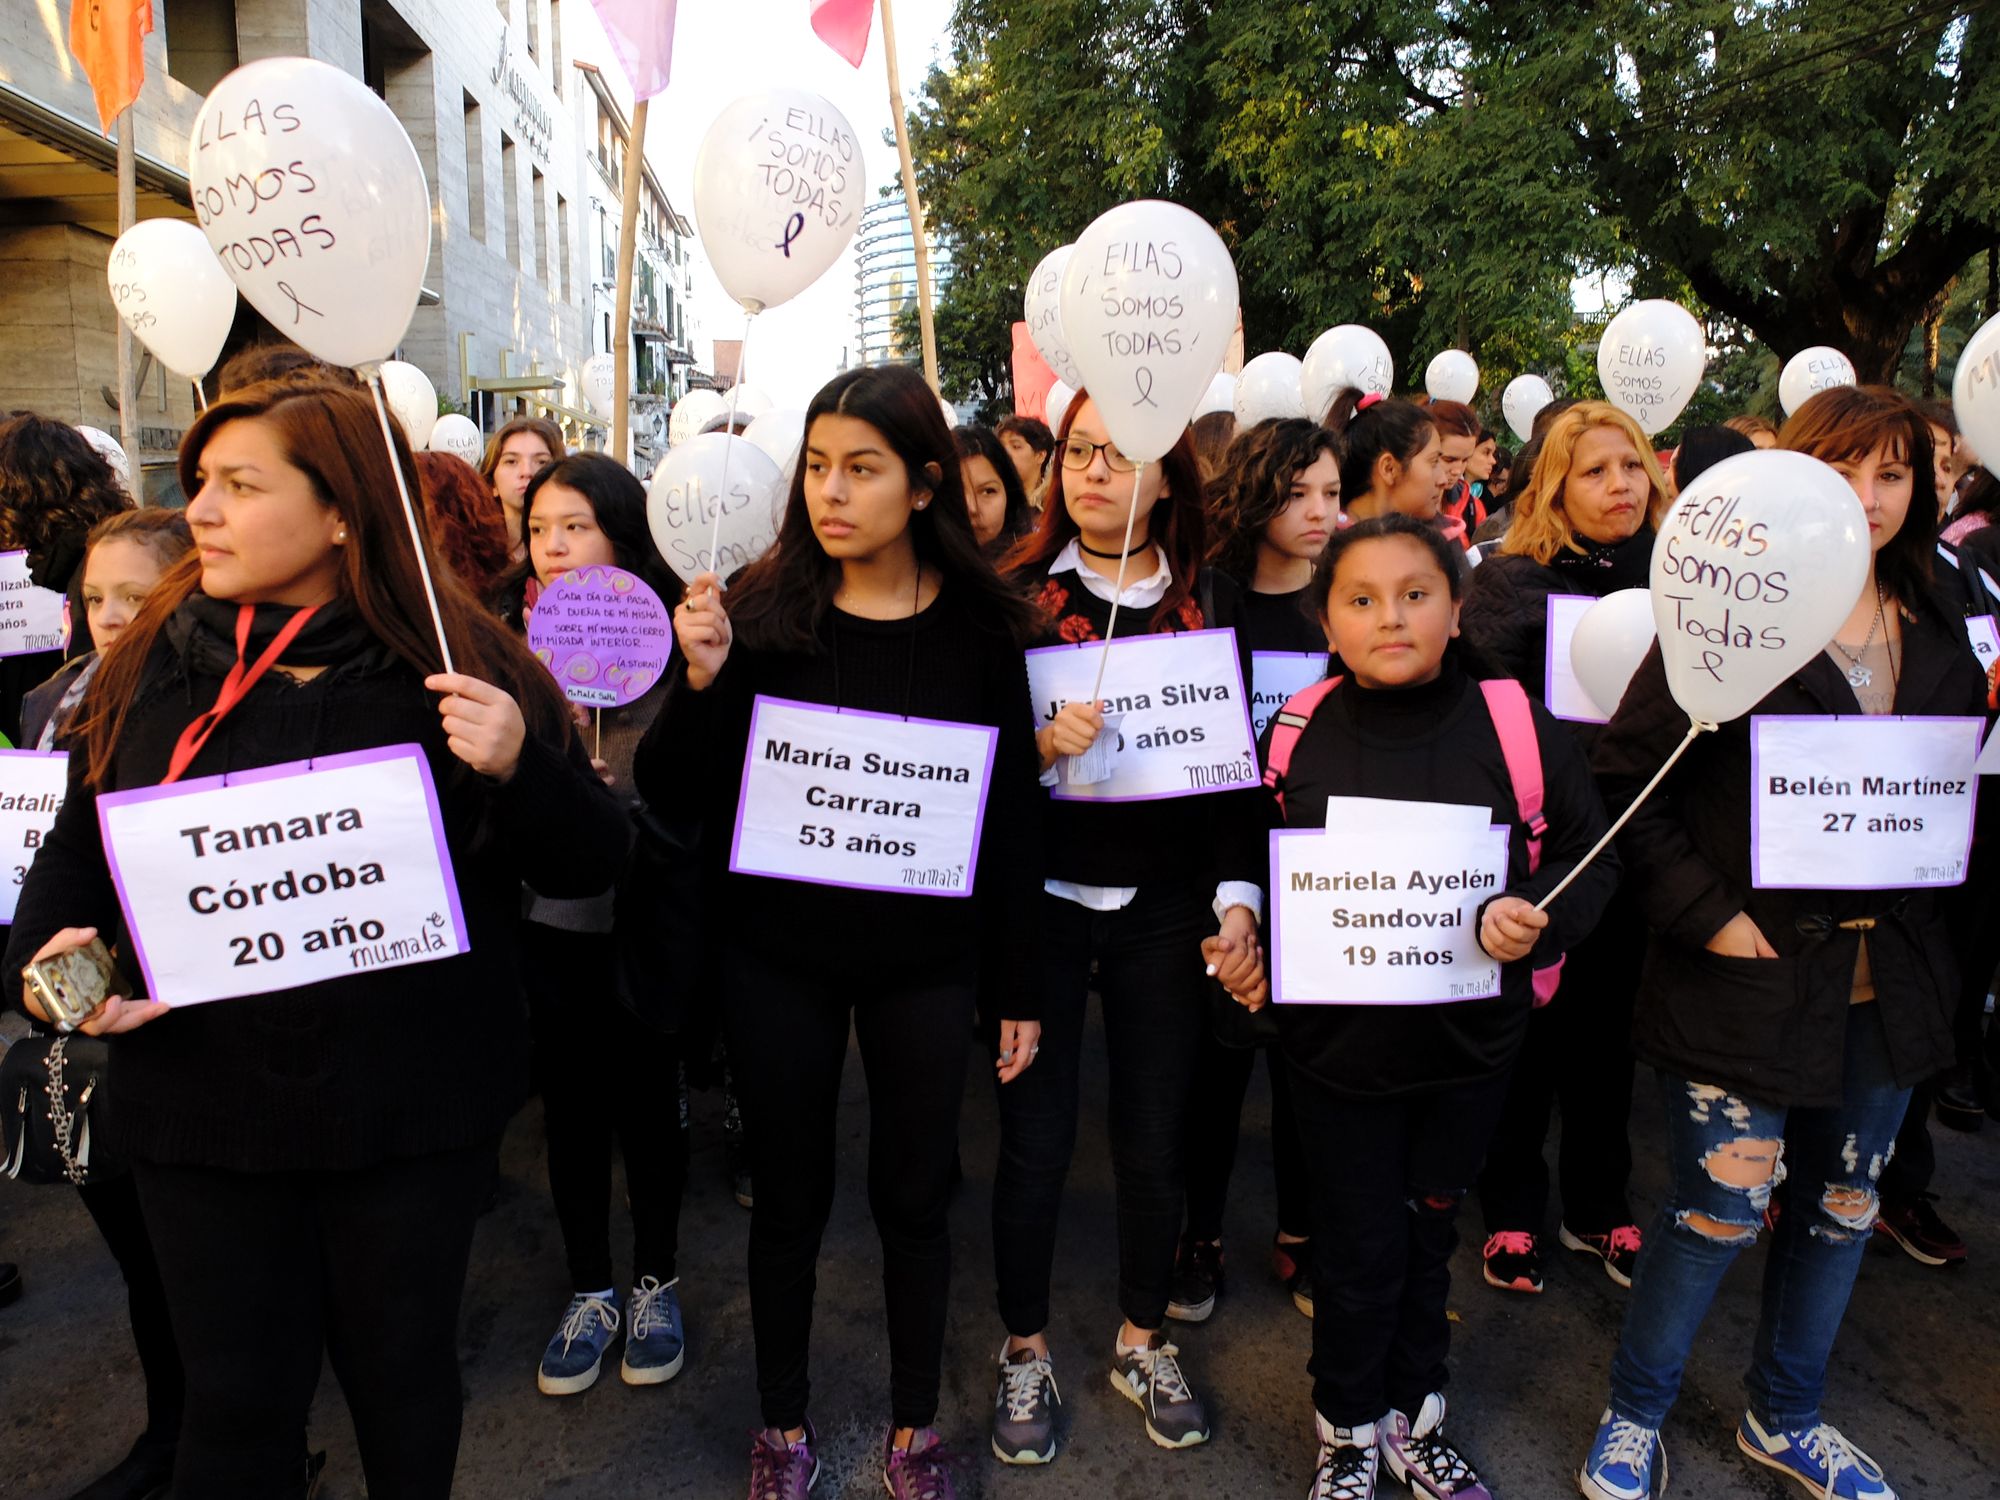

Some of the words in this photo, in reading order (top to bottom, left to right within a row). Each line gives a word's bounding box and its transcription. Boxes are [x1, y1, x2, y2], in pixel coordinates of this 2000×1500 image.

[786, 107, 853, 163] ELLAS
[195, 160, 317, 226] SOMOS
[218, 214, 336, 275] TODAS
[1103, 241, 1183, 280] ELLAS
[1100, 286, 1184, 320] SOMOS
[1618, 344, 1666, 368] ELLAS
[1611, 370, 1663, 391] SOMOS
[665, 481, 751, 529] Ellas
[1677, 495, 1770, 557] #Ellas
[671, 532, 776, 572] Somo
[1662, 535, 1790, 604] Somos
[1663, 593, 1787, 650] Todas
[1043, 690, 1152, 722] Jena
[1160, 682, 1231, 707] Silva
[1134, 725, 1207, 751] años
[764, 739, 852, 772] María
[861, 752, 971, 784] Susana
[0, 791, 65, 813] atali
[805, 785, 922, 819] Carrara
[1768, 774, 1852, 796] Belén
[1861, 774, 1967, 796] Martínez
[180, 806, 364, 859] Tamara
[798, 823, 836, 849] 53
[845, 833, 917, 857] años
[1822, 812, 1858, 833] 27
[1866, 812, 1925, 833] años
[187, 861, 387, 916] Córdoba
[1290, 869, 1397, 892] Mariela
[1406, 867, 1496, 896] Ayelén
[1331, 906, 1463, 929] Sandoval
[228, 931, 286, 968] 20
[302, 916, 386, 954] año
[1342, 944, 1377, 967] 19
[1386, 944, 1455, 967] años
